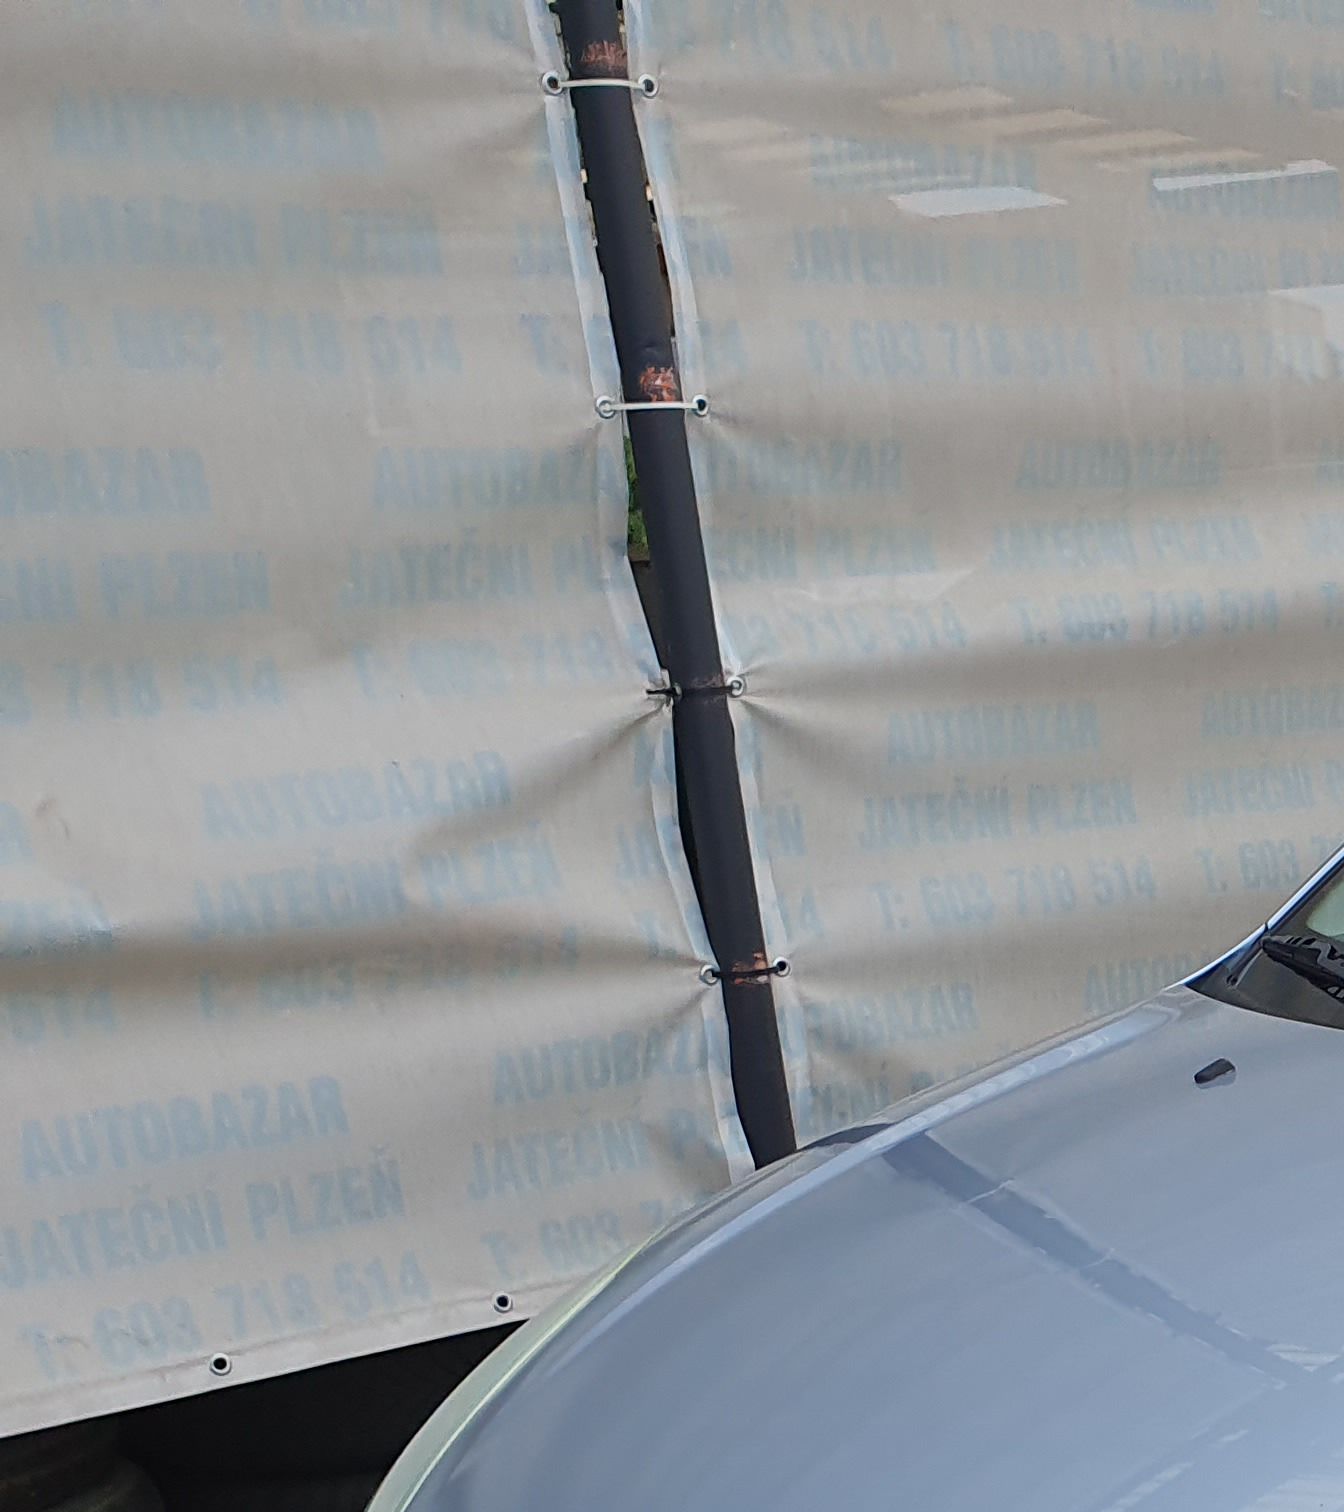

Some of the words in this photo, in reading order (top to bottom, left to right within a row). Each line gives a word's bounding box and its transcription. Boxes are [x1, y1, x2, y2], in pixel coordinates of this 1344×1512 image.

[886, 702, 1100, 766] AUTOBAZAR
[200, 750, 513, 840] AUTOBAZAR
[868, 880, 911, 932] T:
[920, 870, 995, 927] 603
[1005, 865, 1076, 916] 718
[1087, 856, 1157, 909] 514
[1238, 839, 1300, 890] 603
[20, 1073, 350, 1184] AUTOBAZAR
[245, 1142, 407, 1242] PLZEŇ
[538, 1208, 625, 1271] 603
[92, 1294, 203, 1367] 603
[213, 1272, 322, 1339] 718
[333, 1248, 432, 1317] 514
